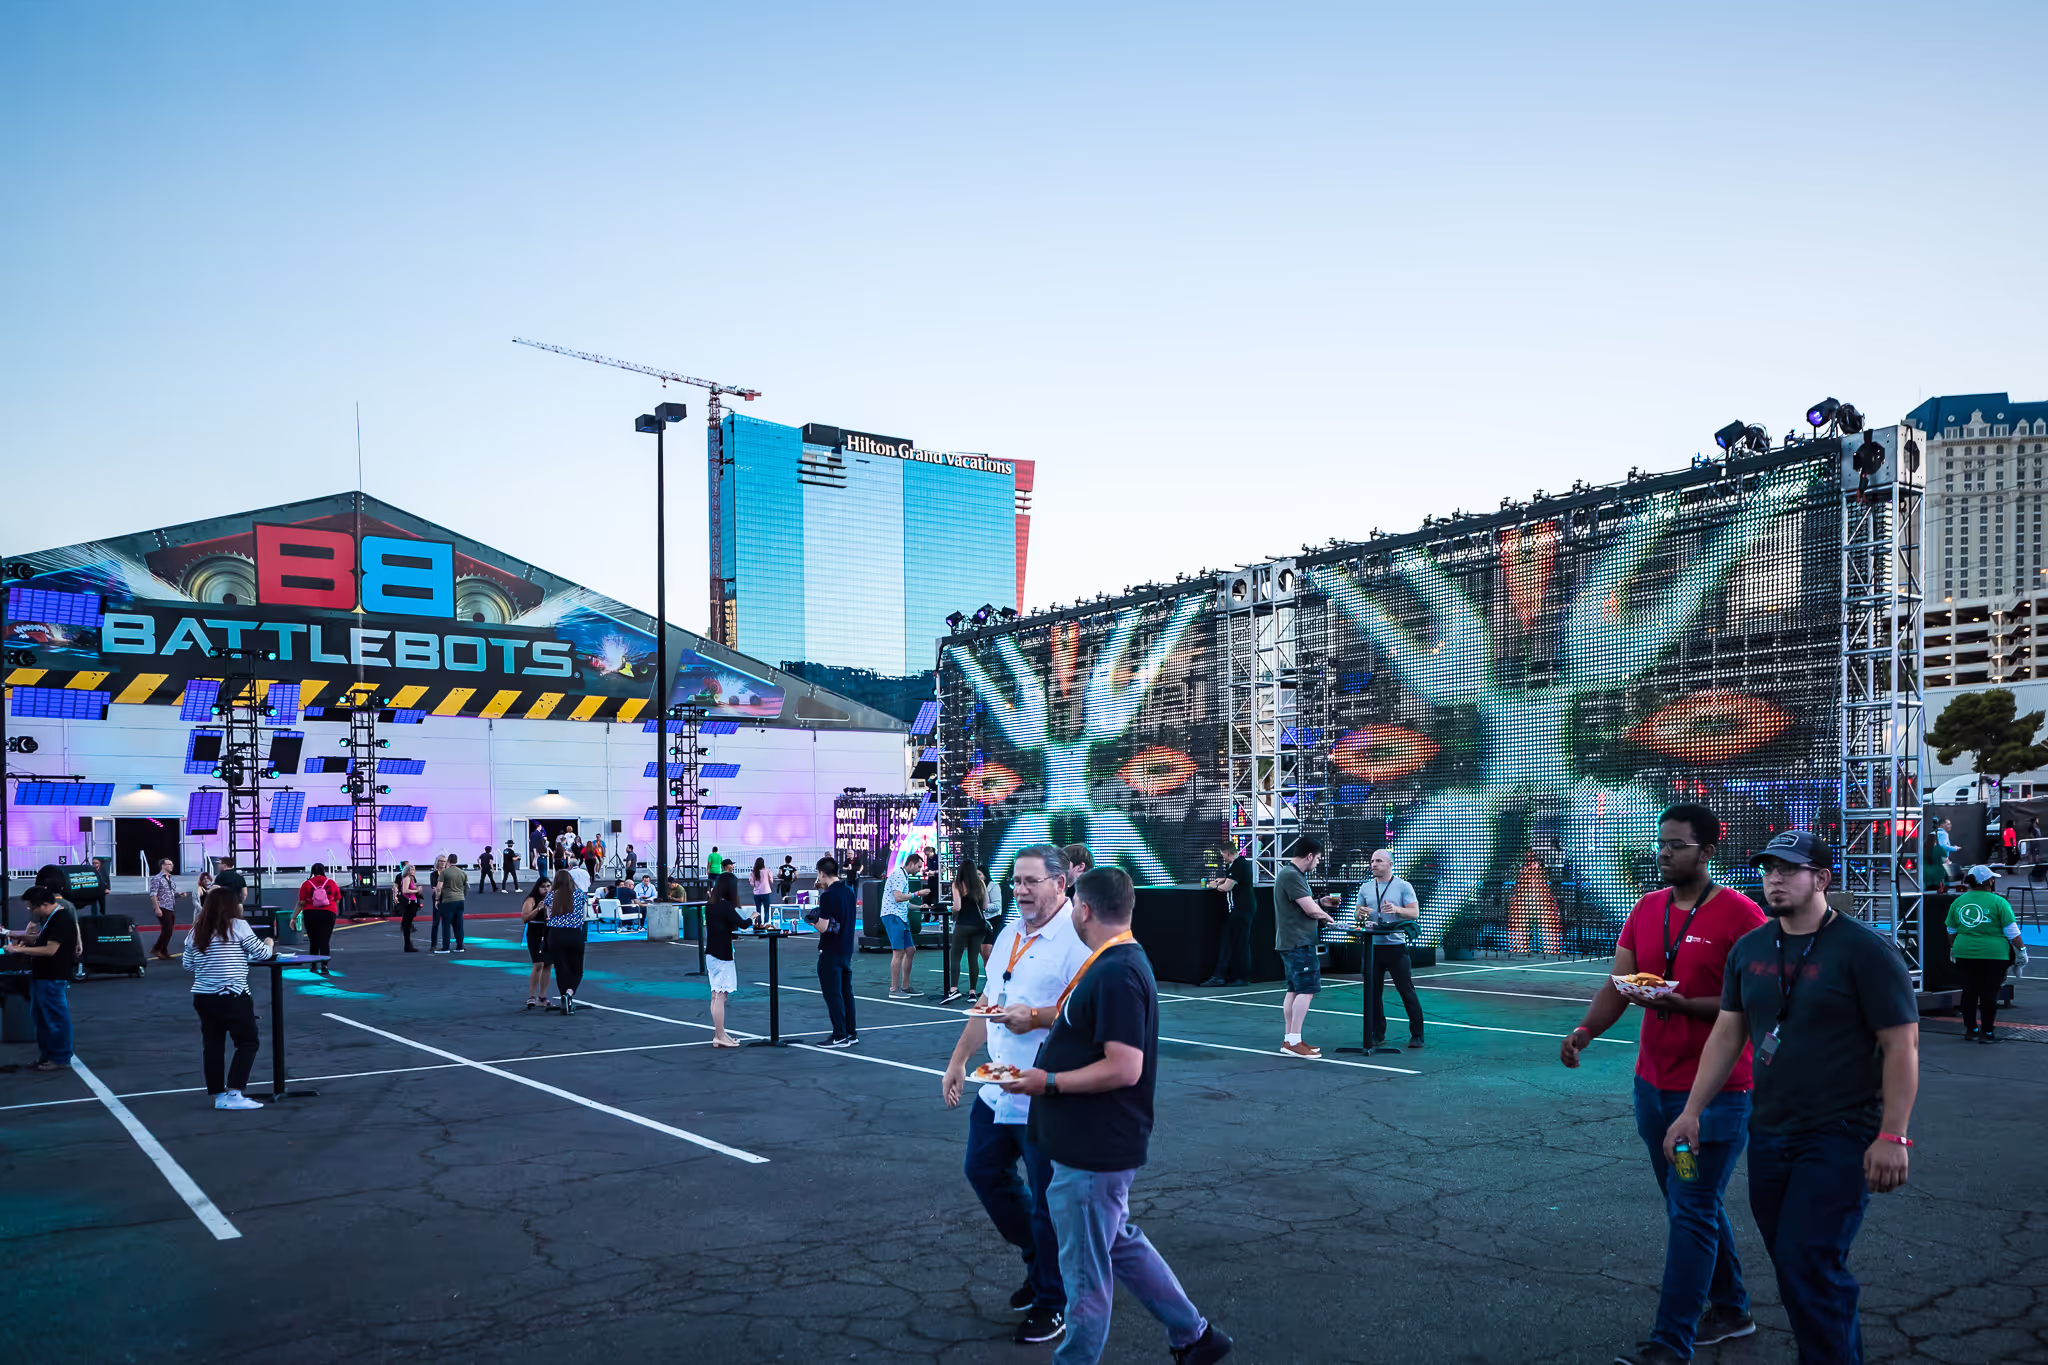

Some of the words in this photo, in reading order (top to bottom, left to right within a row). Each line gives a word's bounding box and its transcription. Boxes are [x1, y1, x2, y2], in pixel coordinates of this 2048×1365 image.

[847, 434, 896, 457] Hilton
[898, 443, 943, 464] Grand
[944, 451, 1012, 475] Vacations
[101, 612, 573, 677] BATTLEBOTS
[836, 808, 865, 820] GRAVITY
[836, 823, 878, 836] BATTLEBOTS
